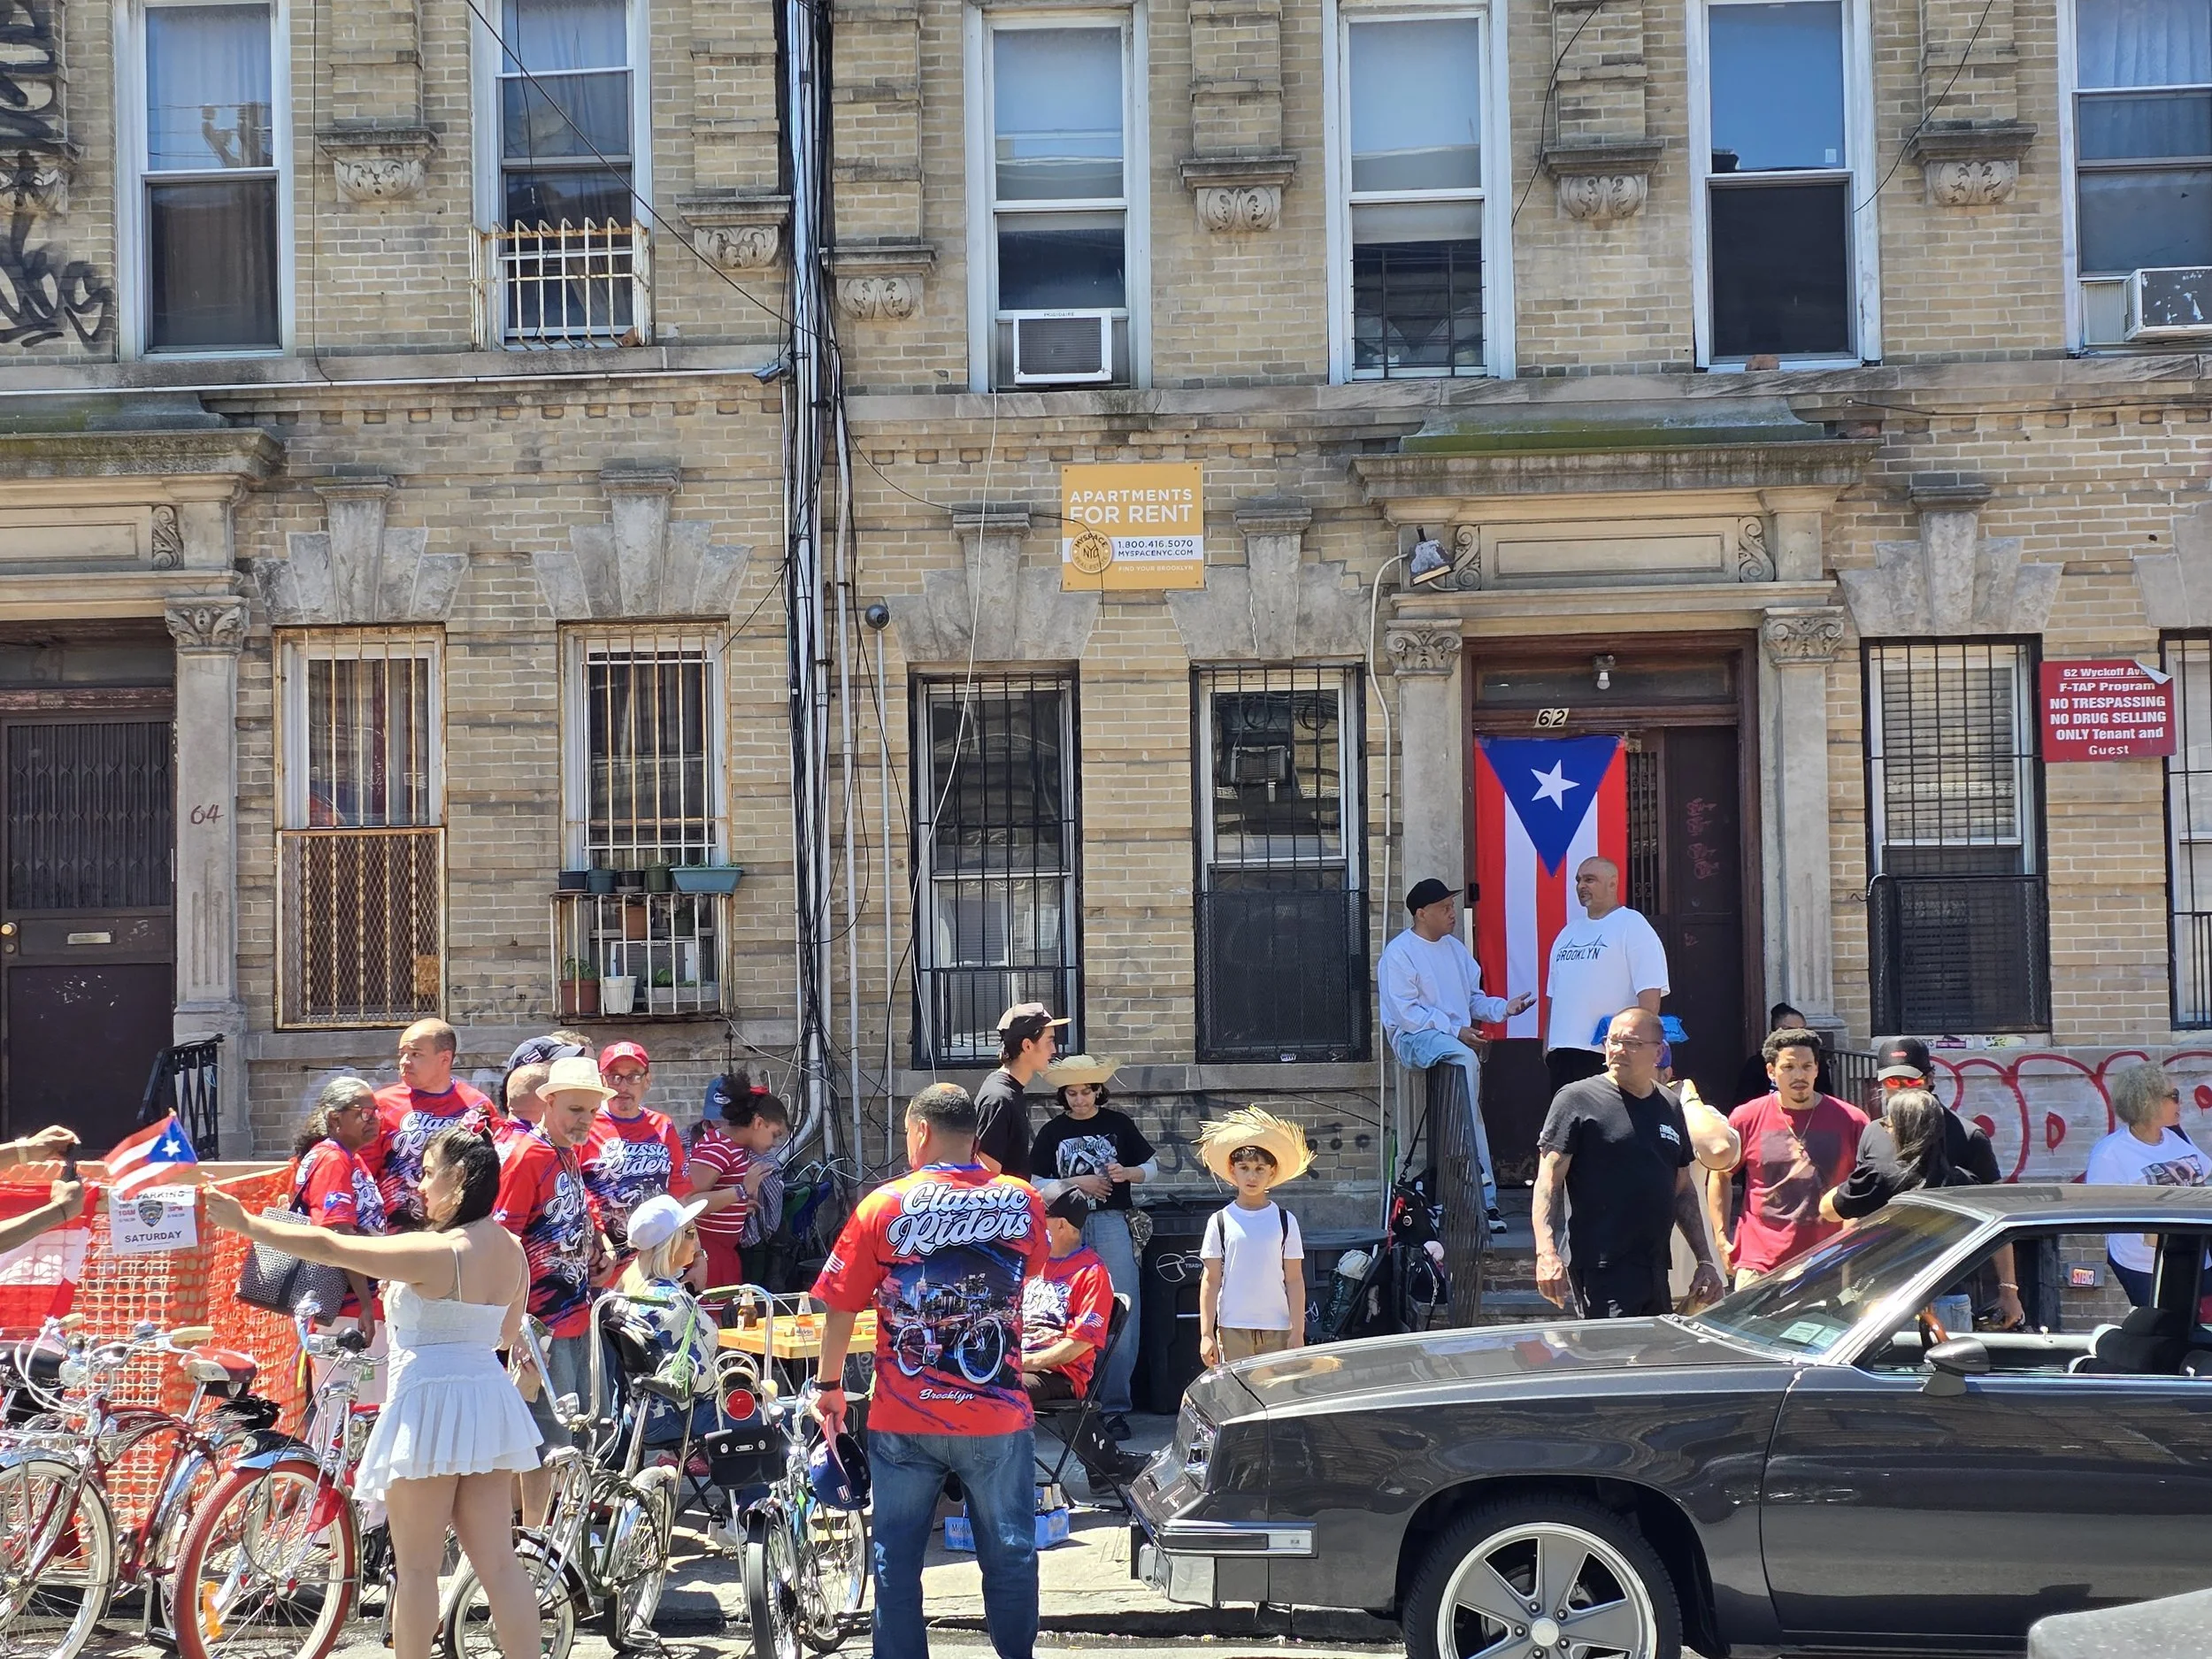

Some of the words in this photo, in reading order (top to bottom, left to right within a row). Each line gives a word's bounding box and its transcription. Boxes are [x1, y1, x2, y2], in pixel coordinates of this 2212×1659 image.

[1070, 488, 1193, 503] APARTMENTS
[1070, 505, 1120, 524] FOR
[1128, 504, 1194, 524] RENT
[1118, 539, 1194, 549] 1.800.416.5070
[1118, 549, 1194, 557] MYSPACENYC.COM
[2080, 668, 2124, 678] Wyckoff
[2059, 683, 2096, 692] F-TAP
[2099, 682, 2155, 693] Program
[2049, 698, 2069, 710] NO
[2071, 696, 2166, 709] TRESPASSING
[1538, 710, 1565, 726] 62
[2050, 714, 2070, 725] NO
[2073, 713, 2109, 725] DRUG
[2112, 711, 2167, 723] SELLING
[2055, 729, 2089, 740] ONLY
[2092, 728, 2136, 740] Tenant
[2139, 727, 2164, 738] and
[2088, 745, 2130, 755] Guest
[190, 803, 225, 825] 64
[901, 1181, 1031, 1217] Classic
[124, 1230, 182, 1243] SATURDAY
[886, 1209, 1033, 1257] Riders
[918, 1388, 975, 1400] Brooklyn
